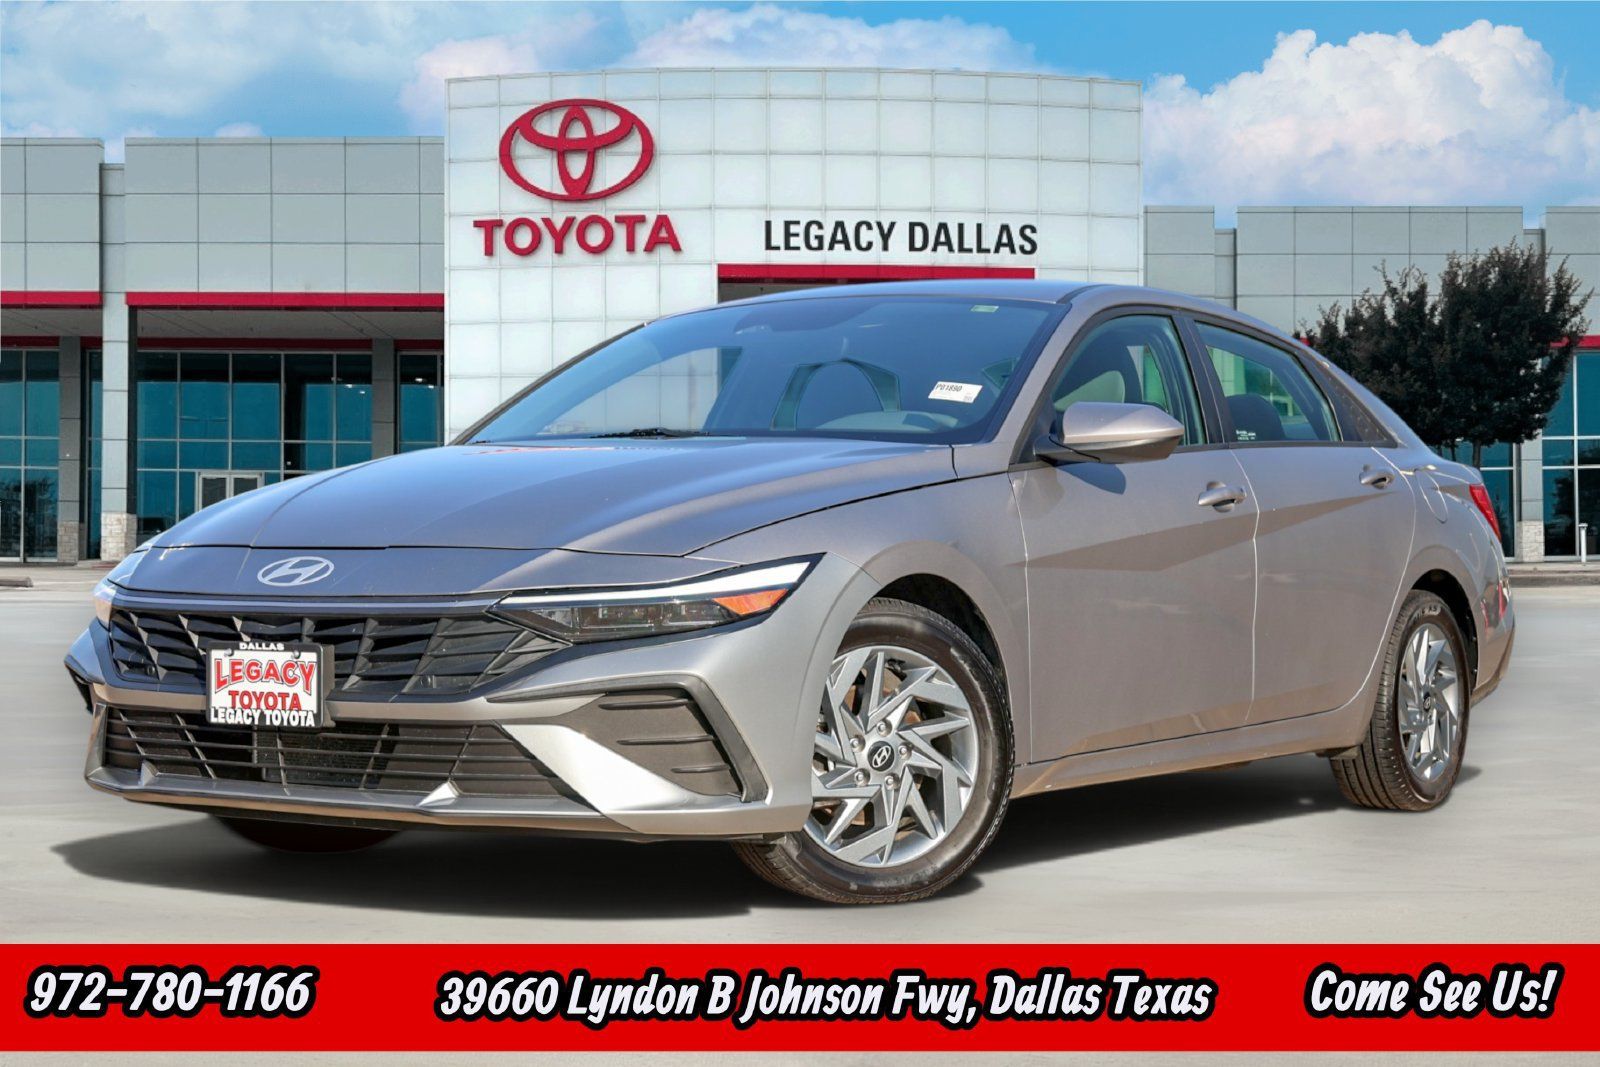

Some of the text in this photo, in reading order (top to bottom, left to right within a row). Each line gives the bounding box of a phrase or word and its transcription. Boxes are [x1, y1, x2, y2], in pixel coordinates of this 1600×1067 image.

[473, 214, 682, 256] TOYOTA
[764, 220, 1038, 255] LEGACY DALLAS
[239, 642, 285, 650] DALLAS
[214, 658, 317, 696] LEGACY
[228, 690, 302, 711] TOYOTA
[210, 707, 315, 727] LEGACY TOYOTA
